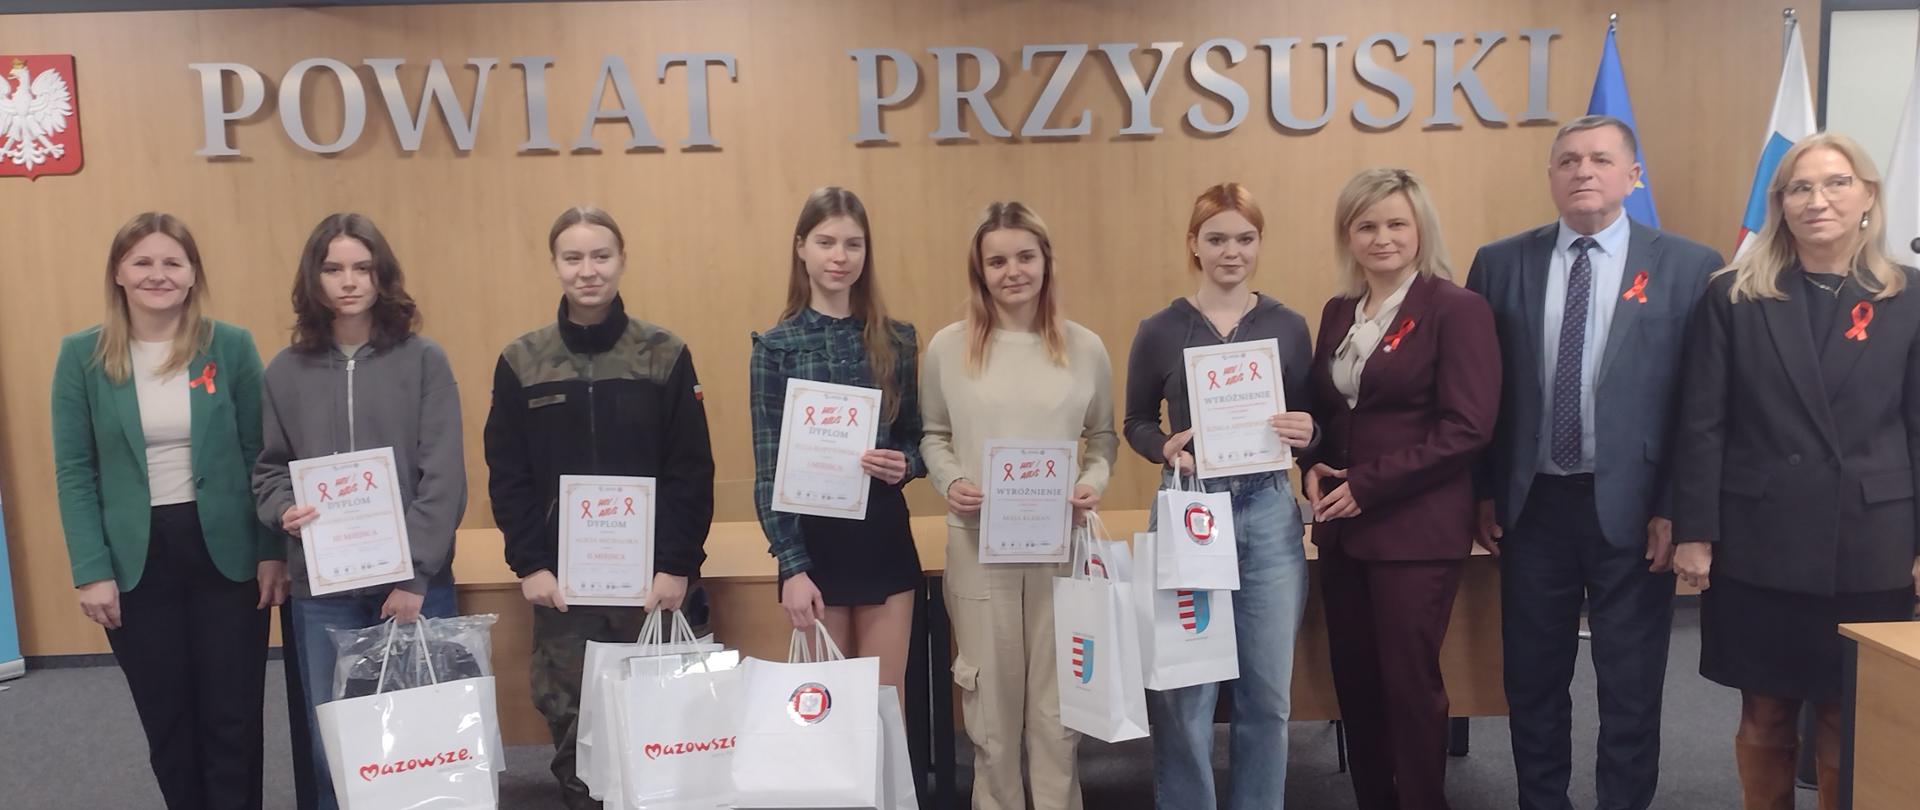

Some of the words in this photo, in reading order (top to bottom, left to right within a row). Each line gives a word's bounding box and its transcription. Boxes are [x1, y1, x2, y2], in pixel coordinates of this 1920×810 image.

[188, 53, 737, 157] POWIAT
[845, 27, 1562, 144] PRZYSUSKI
[809, 427, 849, 439] DYPLOM
[327, 496, 371, 510] DYPLOM
[587, 519, 627, 528] DYPLOM
